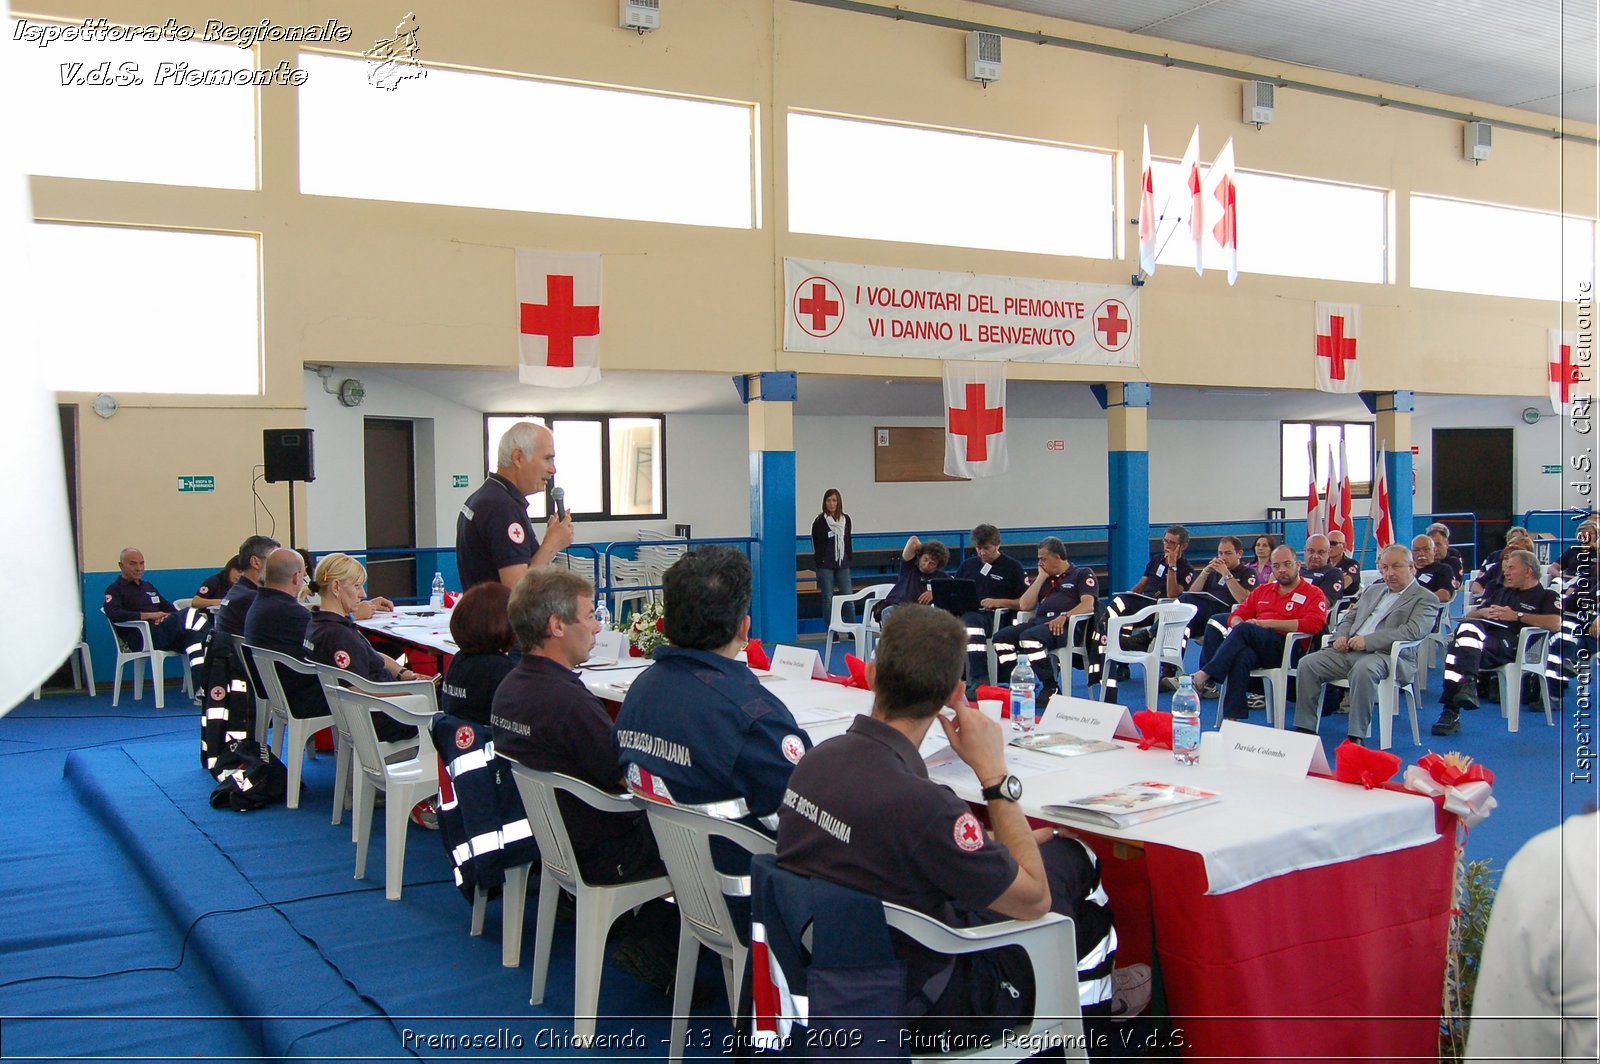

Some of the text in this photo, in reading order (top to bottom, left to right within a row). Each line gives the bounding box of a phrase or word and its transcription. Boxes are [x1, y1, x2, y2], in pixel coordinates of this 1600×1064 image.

[855, 285, 1085, 319] I VOLONTARI DEL PIEMONTE
[868, 317, 1075, 347] VI DANNO IL BENVENUTO
[652, 736, 692, 767] ITALIANA
[1234, 742, 1286, 758] Davide Colombo
[795, 796, 819, 824] ROSSA
[817, 810, 851, 844] ITALIANA
